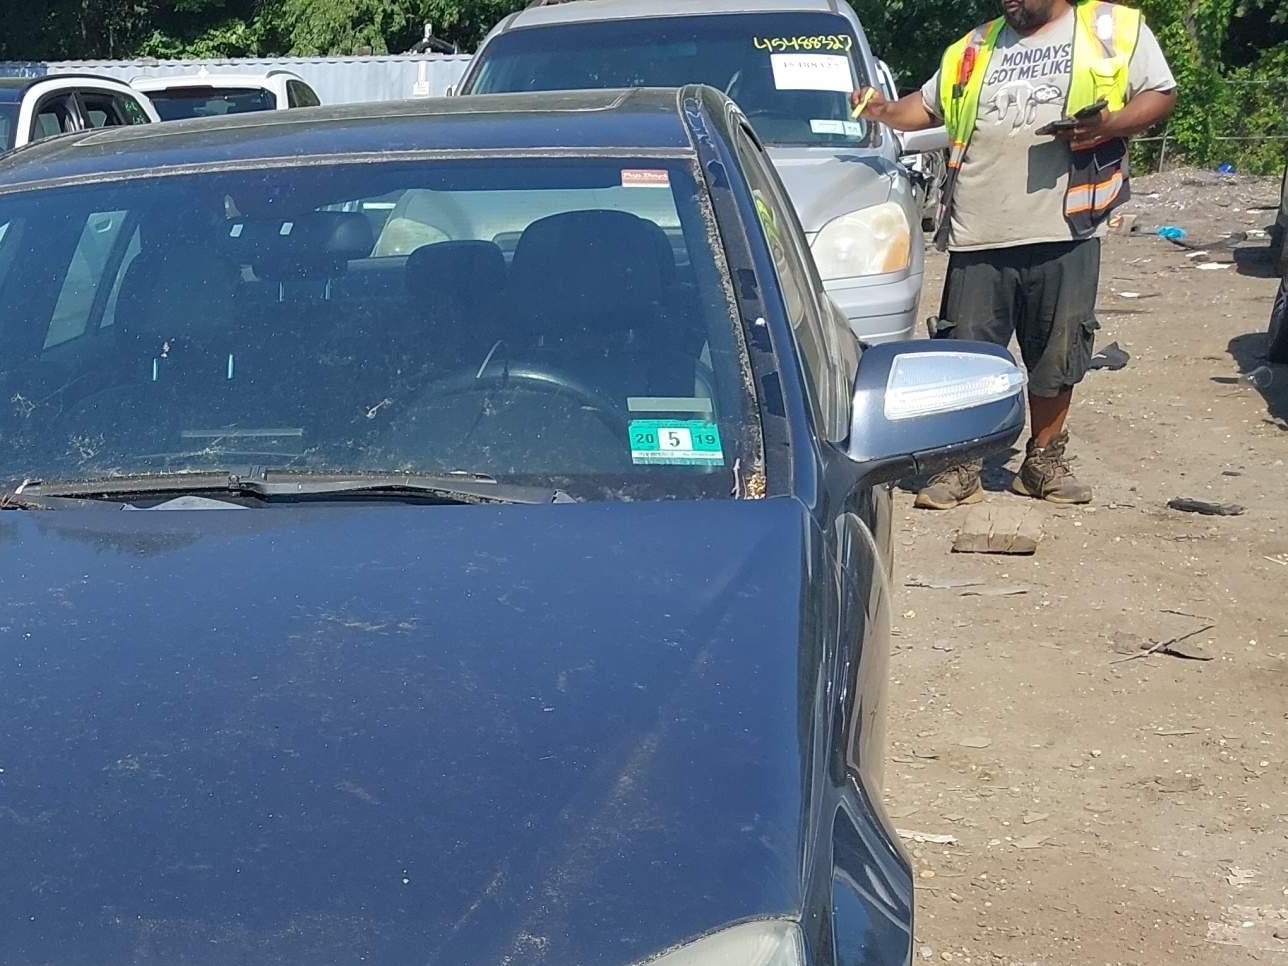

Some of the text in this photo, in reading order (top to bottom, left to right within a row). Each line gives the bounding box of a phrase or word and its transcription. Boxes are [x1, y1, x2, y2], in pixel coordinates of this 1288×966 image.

[753, 34, 852, 52] 45488327
[1001, 43, 1071, 67] MONDAYS
[988, 59, 1072, 86] GOT ME LIKE
[635, 431, 716, 447] 20 5 19
